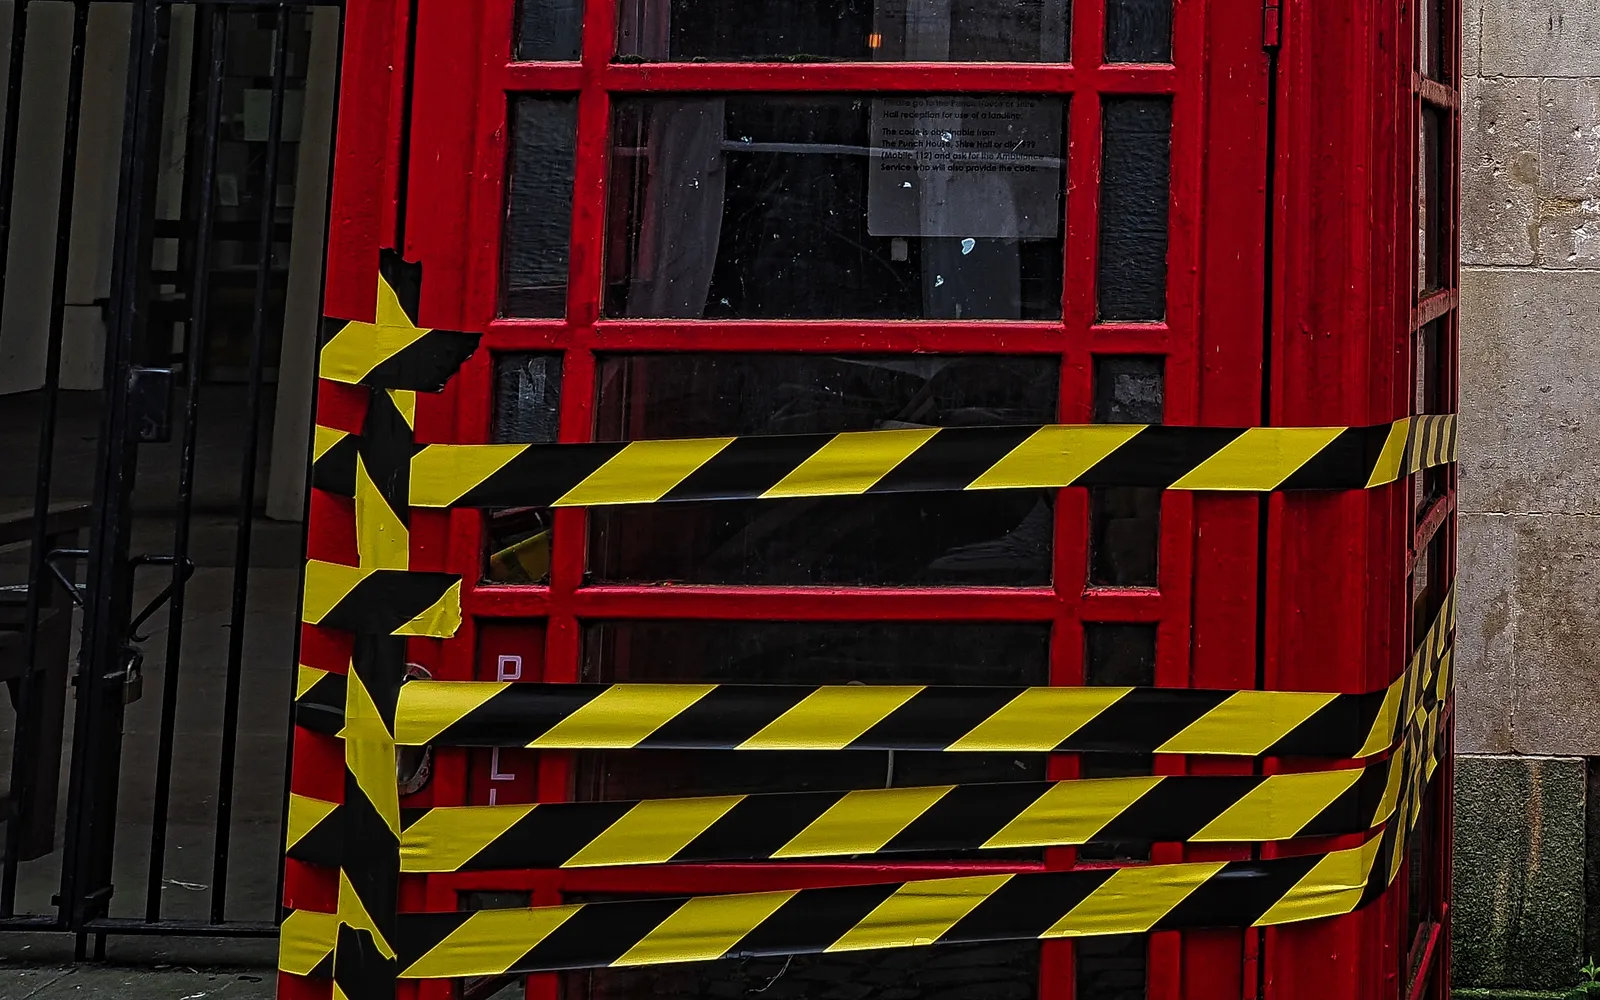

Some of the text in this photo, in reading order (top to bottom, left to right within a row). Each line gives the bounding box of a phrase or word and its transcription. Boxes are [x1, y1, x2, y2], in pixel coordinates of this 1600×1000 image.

[883, 111, 899, 119] Hall
[900, 111, 940, 119] reception
[942, 111, 953, 119] for
[954, 111, 969, 119] use
[971, 111, 980, 119] of
[980, 111, 987, 119] a
[882, 127, 897, 136] The
[899, 127, 919, 136] code
[976, 127, 996, 136] from
[881, 139, 896, 148] The
[898, 139, 923, 148] Punch
[976, 139, 993, 148] Hall
[994, 139, 1002, 148] or
[934, 151, 951, 161] and
[952, 151, 967, 161] ask
[880, 164, 911, 173] Service
[913, 164, 931, 173] who
[966, 164, 997, 173] provide
[999, 164, 1012, 173] the
